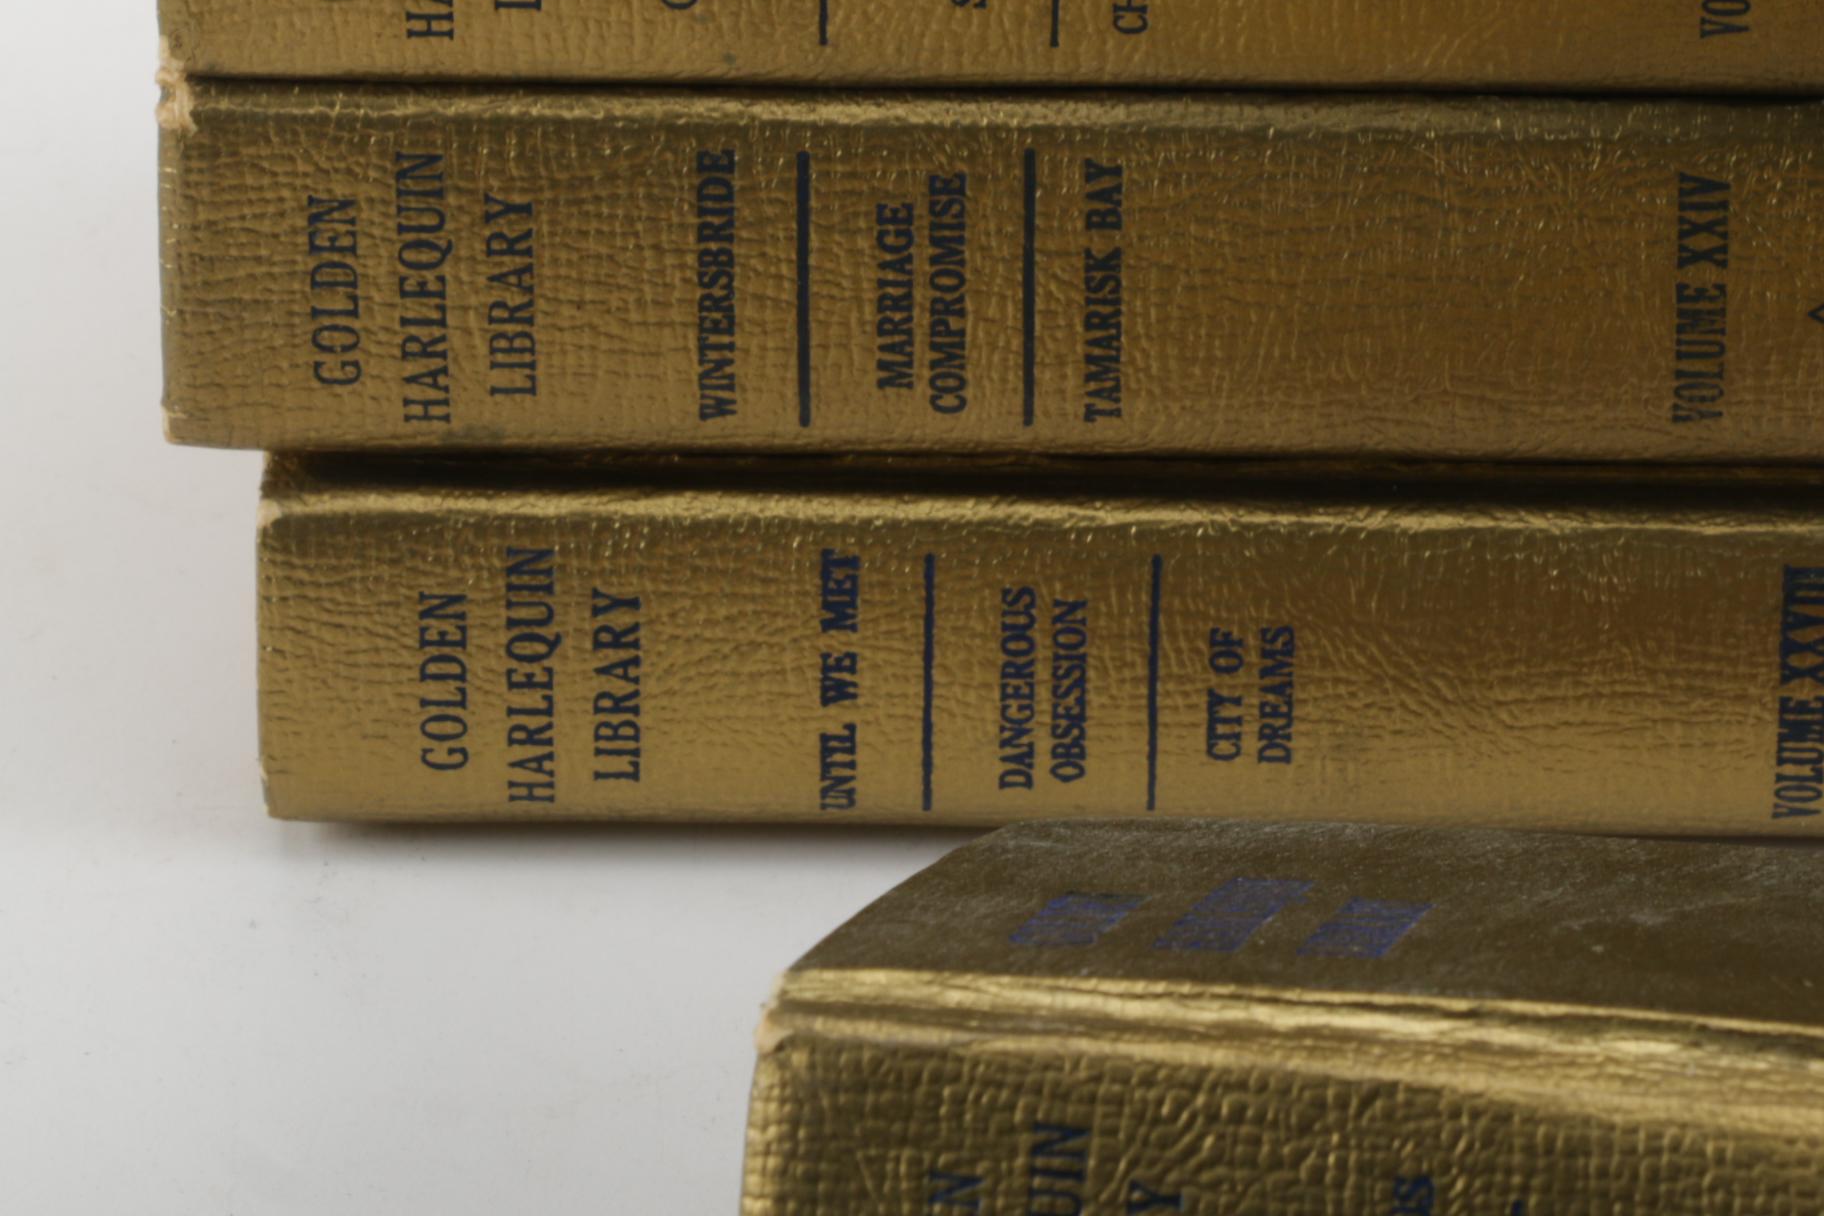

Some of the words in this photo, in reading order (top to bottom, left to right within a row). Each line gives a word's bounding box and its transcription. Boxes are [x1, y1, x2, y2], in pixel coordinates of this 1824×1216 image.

[696, 149, 738, 420] WINTERSBRIDE
[1085, 160, 1125, 230] BAY
[1676, 172, 1730, 268] XXIV
[306, 195, 363, 385] GOLDEN
[395, 152, 454, 421] HARLEQUIN
[485, 193, 538, 396] LIBRARY
[877, 203, 917, 387] MARRIAGE
[929, 173, 968, 413] COMPROMISE
[1084, 250, 1123, 421] TAMARISK
[1674, 283, 1728, 423] VOLUME
[505, 548, 563, 804] HARLEQUIN
[821, 549, 861, 631] MET
[822, 652, 857, 704] WE
[1210, 627, 1245, 674] OF
[419, 592, 469, 771] GOLDEN
[593, 590, 641, 780] LIBRARY
[821, 724, 856, 809] UNTIL
[999, 587, 1037, 789] DANGEROUS
[1051, 599, 1088, 782] OBSESSION
[1208, 689, 1243, 761] CITY
[1259, 626, 1295, 763] DREAMS
